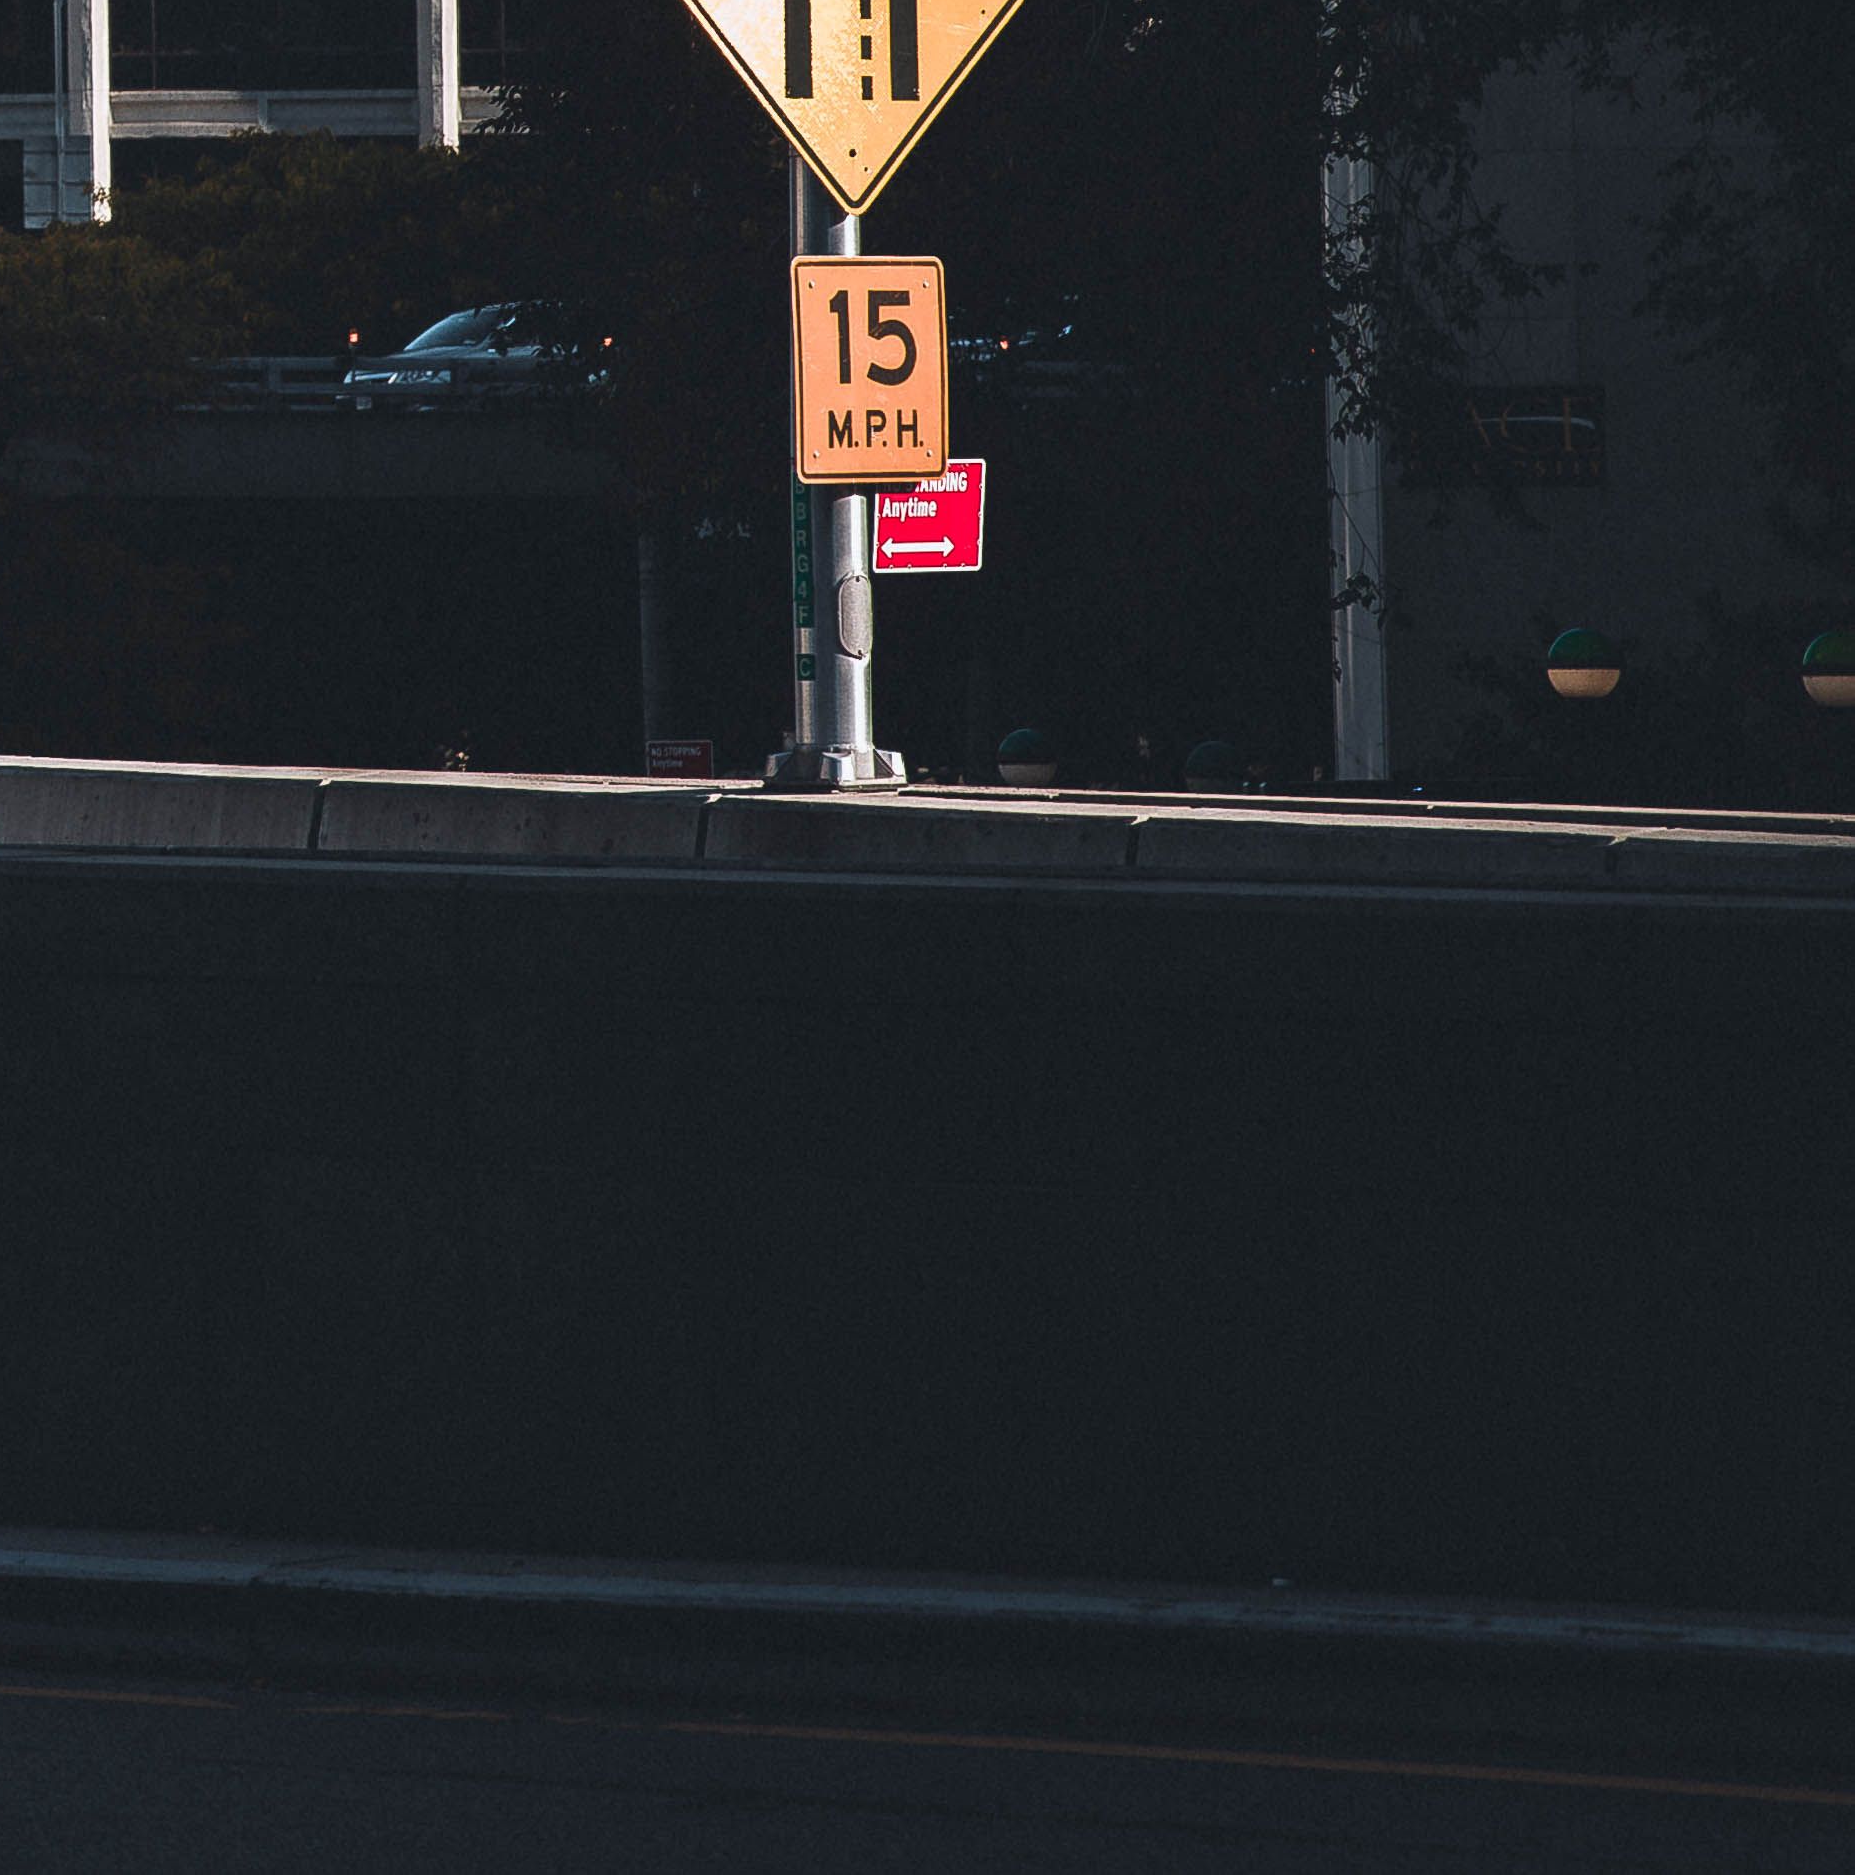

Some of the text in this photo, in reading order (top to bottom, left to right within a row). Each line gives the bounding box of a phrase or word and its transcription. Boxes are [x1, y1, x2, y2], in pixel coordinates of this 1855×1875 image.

[829, 290, 917, 386] 15
[827, 409, 924, 448] M.P.H.
[882, 496, 938, 522] Anytime
[651, 746, 702, 758] NO STOPPING
